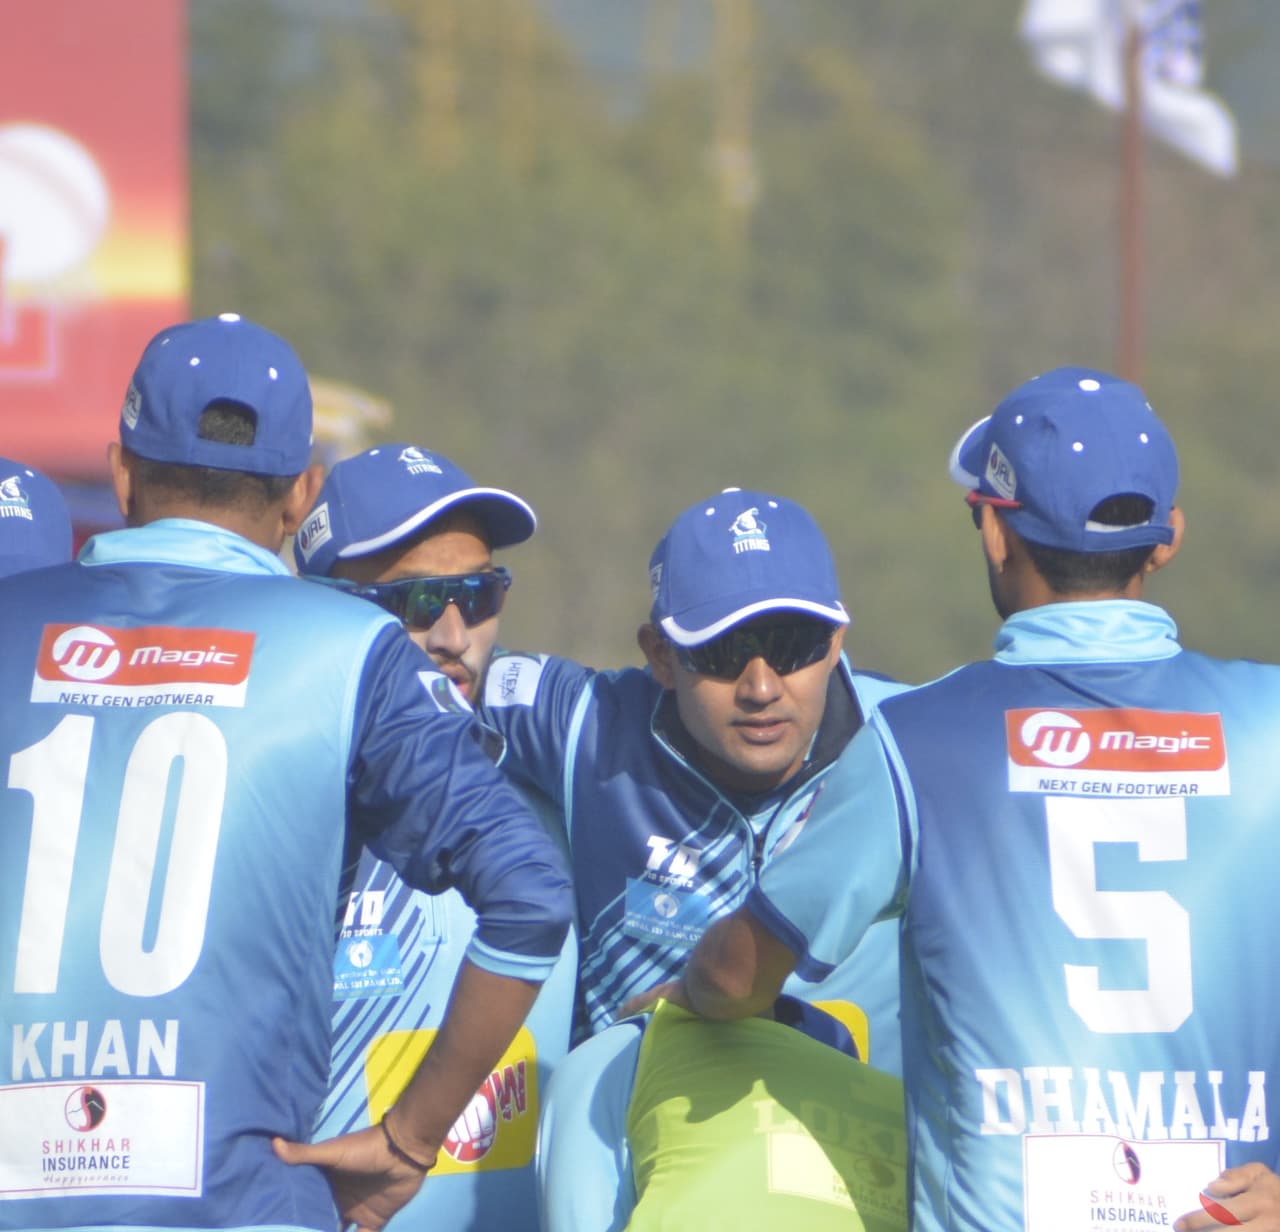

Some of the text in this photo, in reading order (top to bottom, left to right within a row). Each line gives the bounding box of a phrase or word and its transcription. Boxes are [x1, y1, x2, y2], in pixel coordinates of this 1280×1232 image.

[128, 645, 239, 667] Magic
[58, 691, 214, 707] NEXT GEN FOOTWEAR
[1099, 731, 1212, 753] Magic
[1039, 778, 1199, 795] NEXT GEN FOOTWEAR
[7, 711, 228, 999] 10
[1045, 796, 1194, 1034] 5
[12, 1018, 180, 1082] KHAN
[975, 1066, 1270, 1143] DHAMALA
[42, 1138, 132, 1155] SHIKHAR
[42, 1154, 132, 1173] INSURANCE
[1090, 1206, 1170, 1226] INSURANCE
